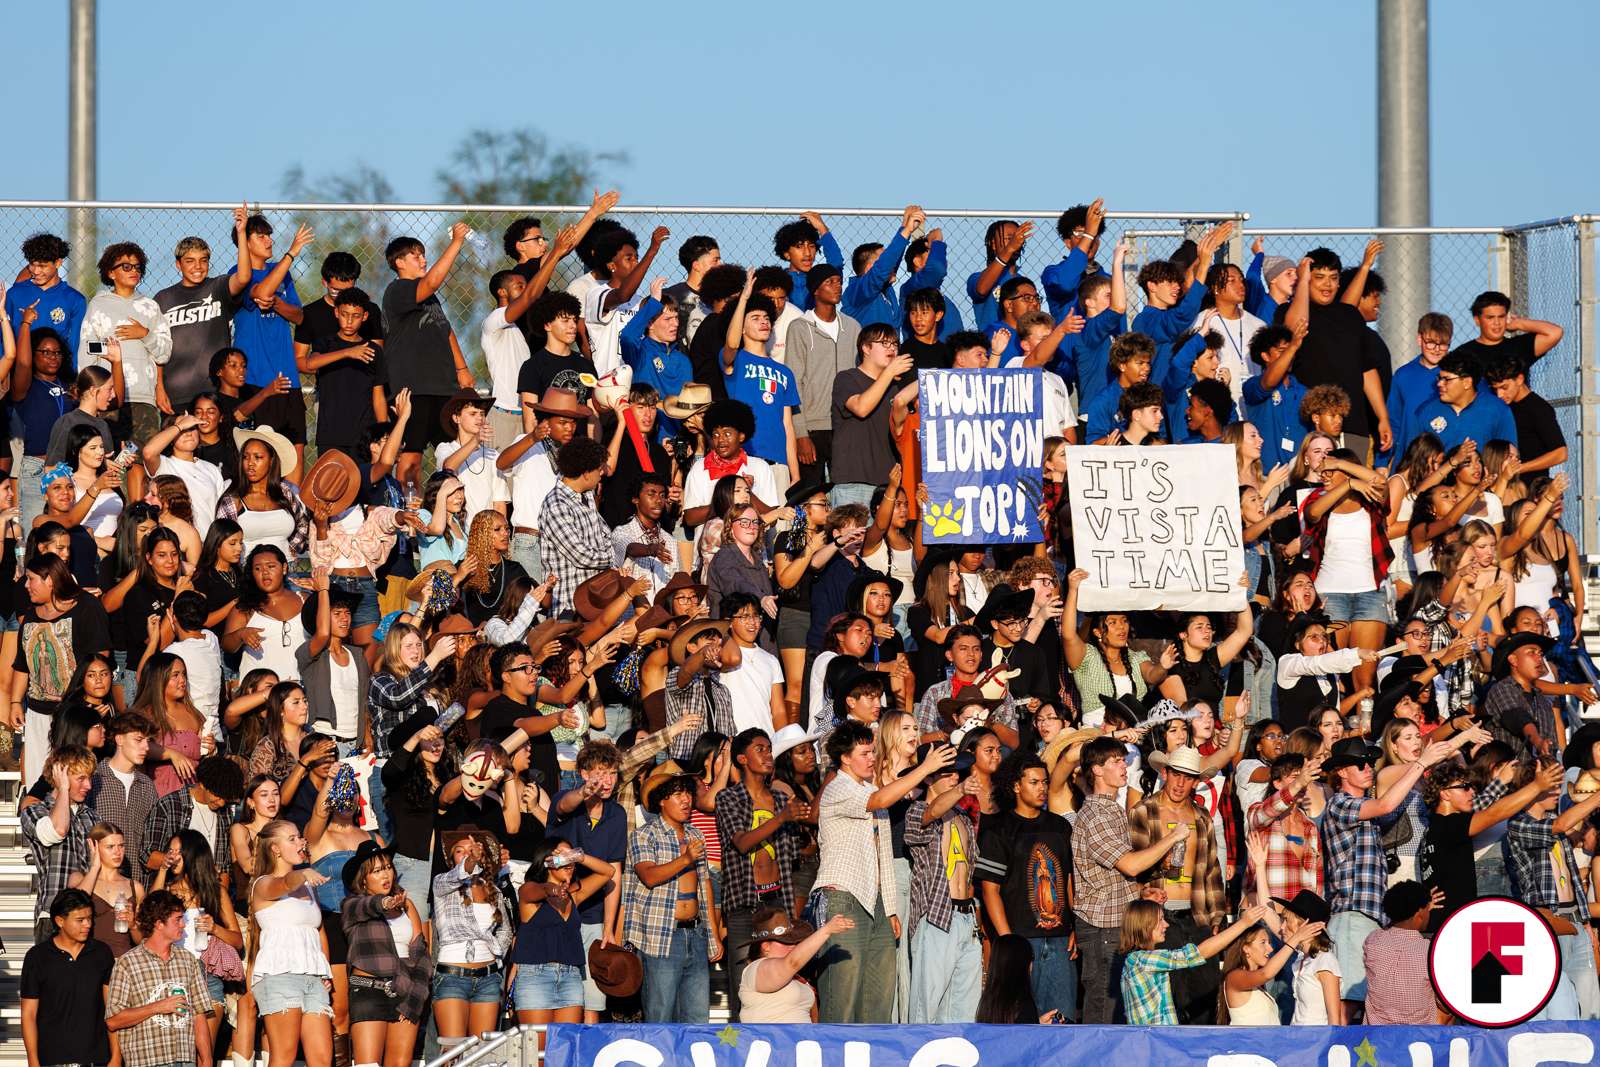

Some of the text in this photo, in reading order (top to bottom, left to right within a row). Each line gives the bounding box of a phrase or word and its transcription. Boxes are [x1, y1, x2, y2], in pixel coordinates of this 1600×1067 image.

[925, 373, 1034, 417] MOUNTAIN
[925, 418, 1043, 473] LIONS ON
[1081, 458, 1174, 503] IT'S
[954, 481, 1031, 543] TOP!
[1084, 505, 1239, 548] VISTA
[1091, 548, 1231, 593] TIME
